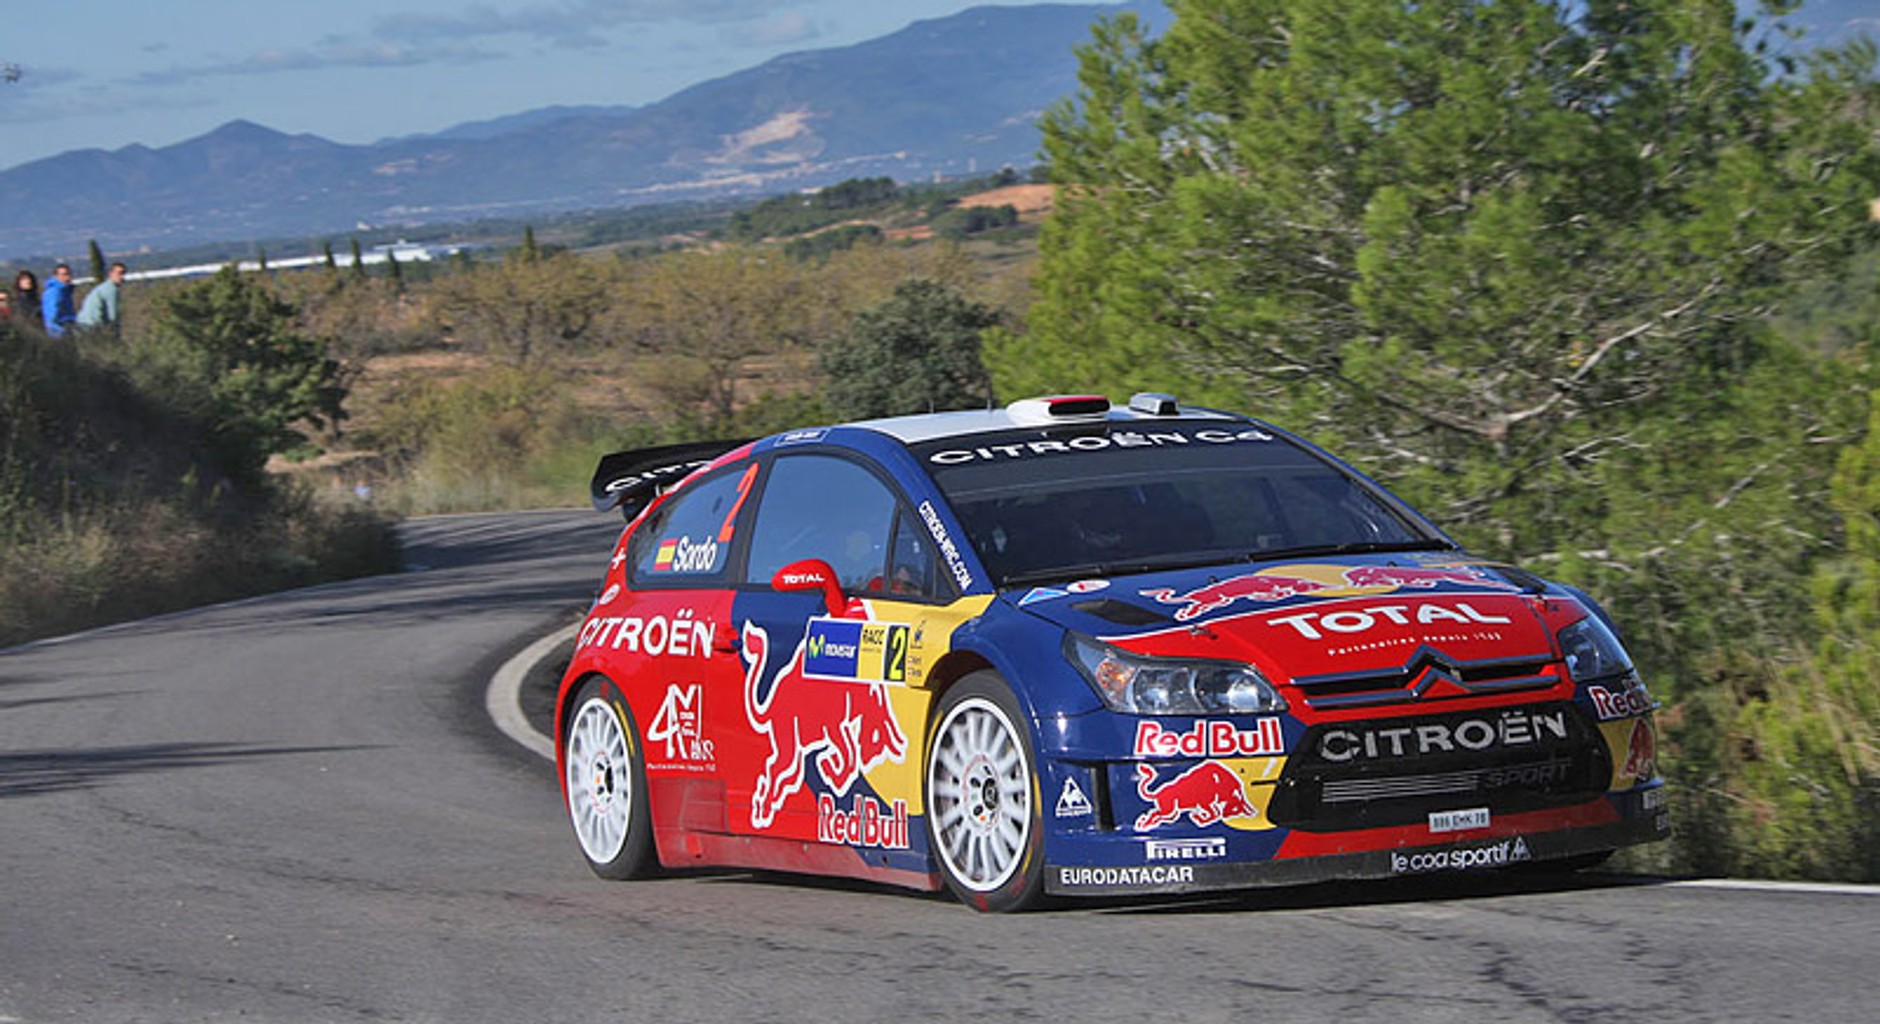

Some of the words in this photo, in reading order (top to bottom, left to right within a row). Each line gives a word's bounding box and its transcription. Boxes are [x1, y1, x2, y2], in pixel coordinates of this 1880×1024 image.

[930, 431, 1188, 463] CITROËN
[1196, 430, 1273, 442] C4
[717, 462, 760, 543] 2
[673, 535, 717, 572] Sordo
[782, 573, 825, 585] TOTAL
[576, 608, 716, 659] CITROËN
[1266, 602, 1511, 640] TOTAL
[888, 626, 906, 681] 2
[1134, 719, 1206, 757] Red
[1208, 716, 1284, 756] Bull
[1321, 711, 1568, 762] CITROËN
[818, 792, 861, 845] Red
[864, 796, 909, 849] Bull
[1146, 837, 1226, 860] PIRELLI
[1391, 852, 1408, 872] le
[1450, 841, 1510, 870] sportif
[1060, 866, 1194, 885] EURODATACAR
